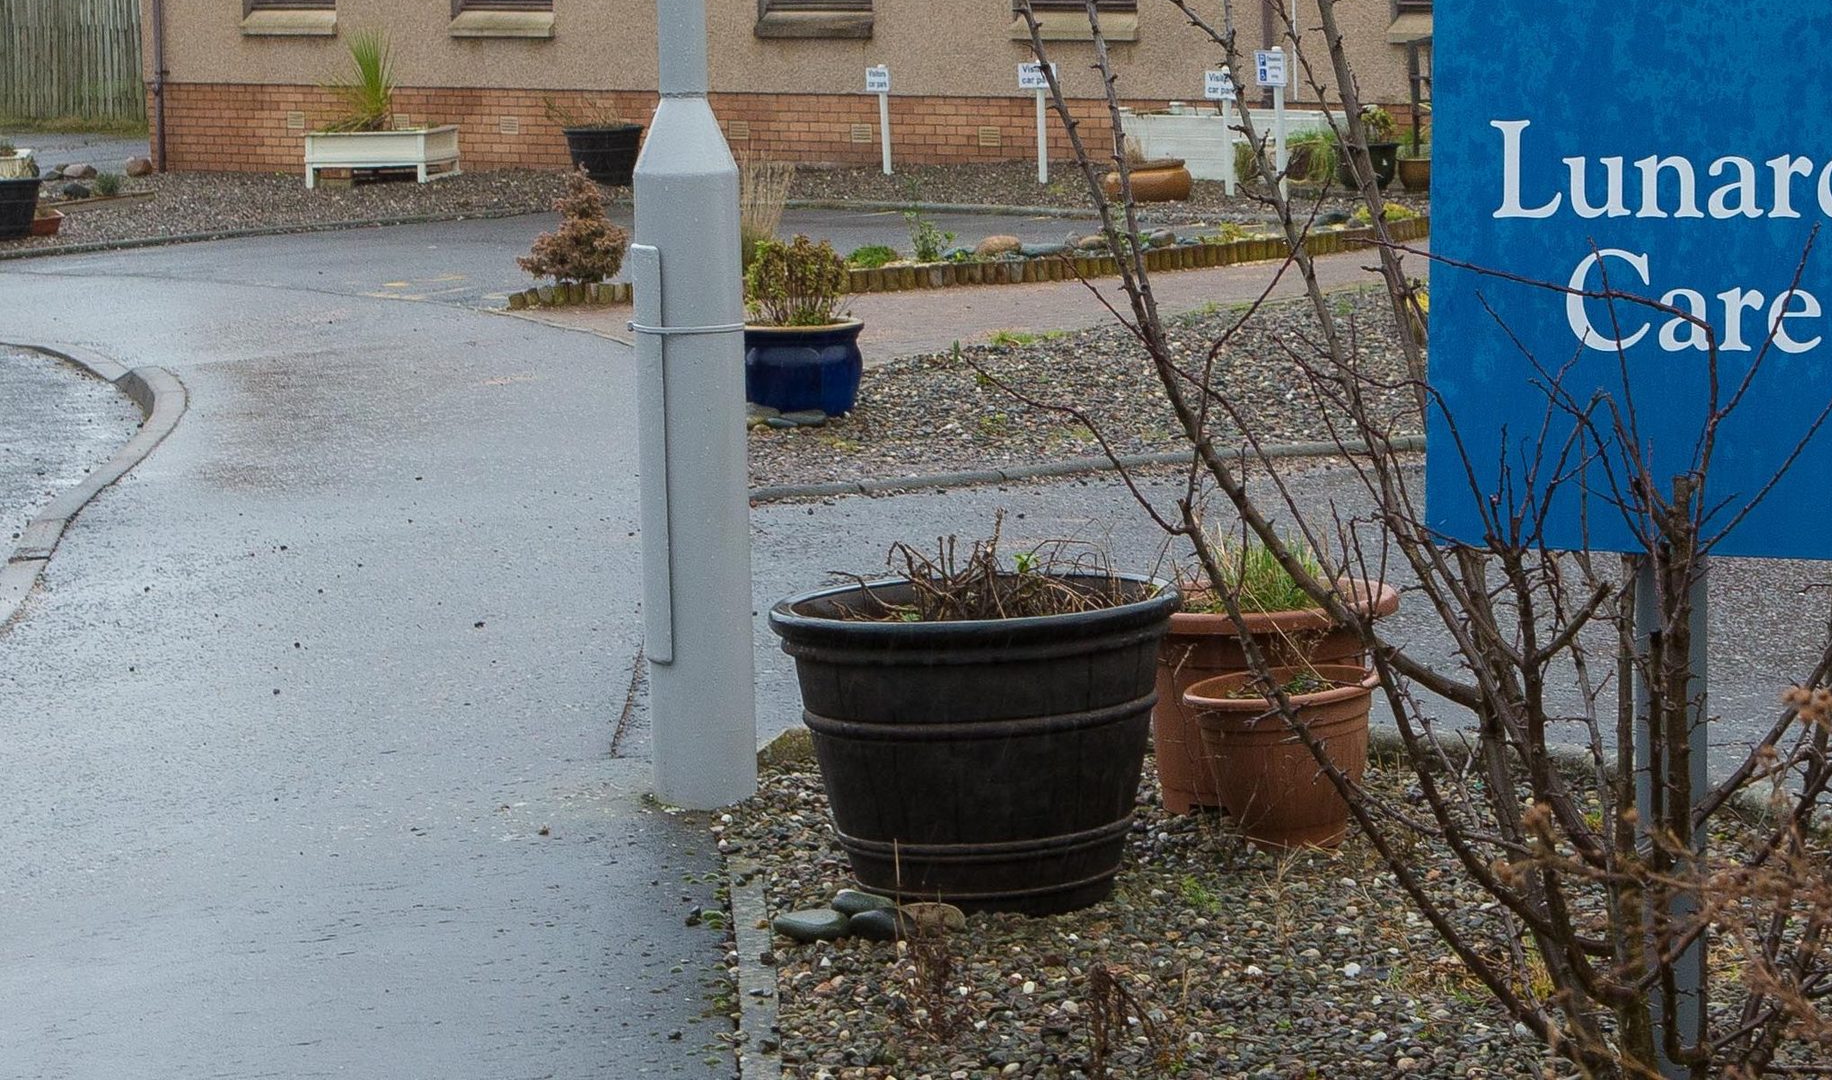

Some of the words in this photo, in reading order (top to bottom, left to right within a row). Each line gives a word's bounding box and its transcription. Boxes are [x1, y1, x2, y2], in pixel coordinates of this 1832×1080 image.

[1021, 76, 1034, 84] car
[1208, 86, 1218, 94] car
[1566, 248, 1823, 354] Care
